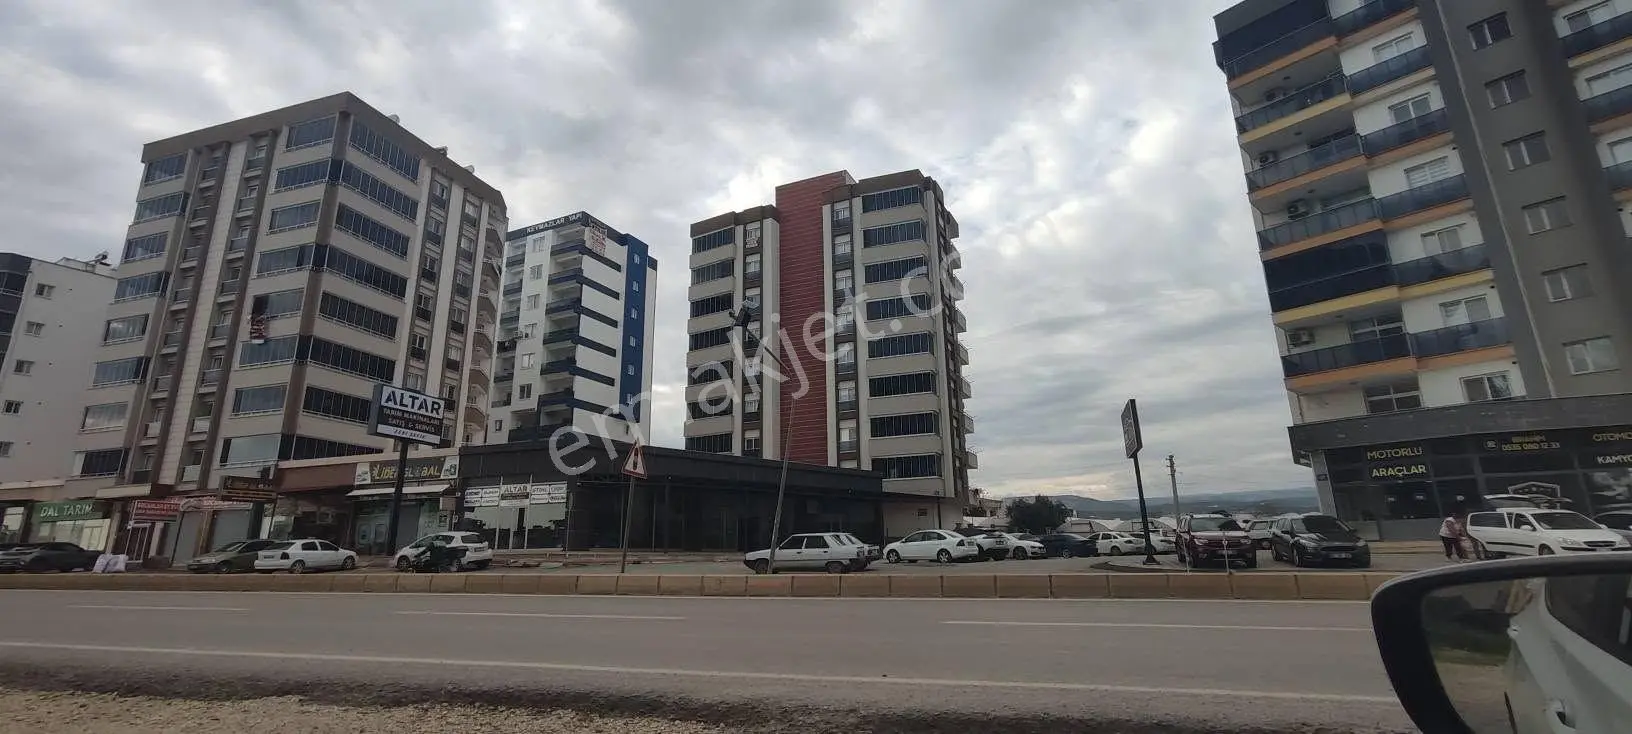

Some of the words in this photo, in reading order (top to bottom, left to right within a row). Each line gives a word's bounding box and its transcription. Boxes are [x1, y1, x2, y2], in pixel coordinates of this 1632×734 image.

[384, 390, 442, 415] ALTAR
[1367, 446, 1423, 460] MOTORLU
[1372, 464, 1427, 478] ARAÇLAR
[503, 485, 528, 493] ALTAR
[40, 506, 60, 517] DAL
[63, 503, 94, 516] TARIM
